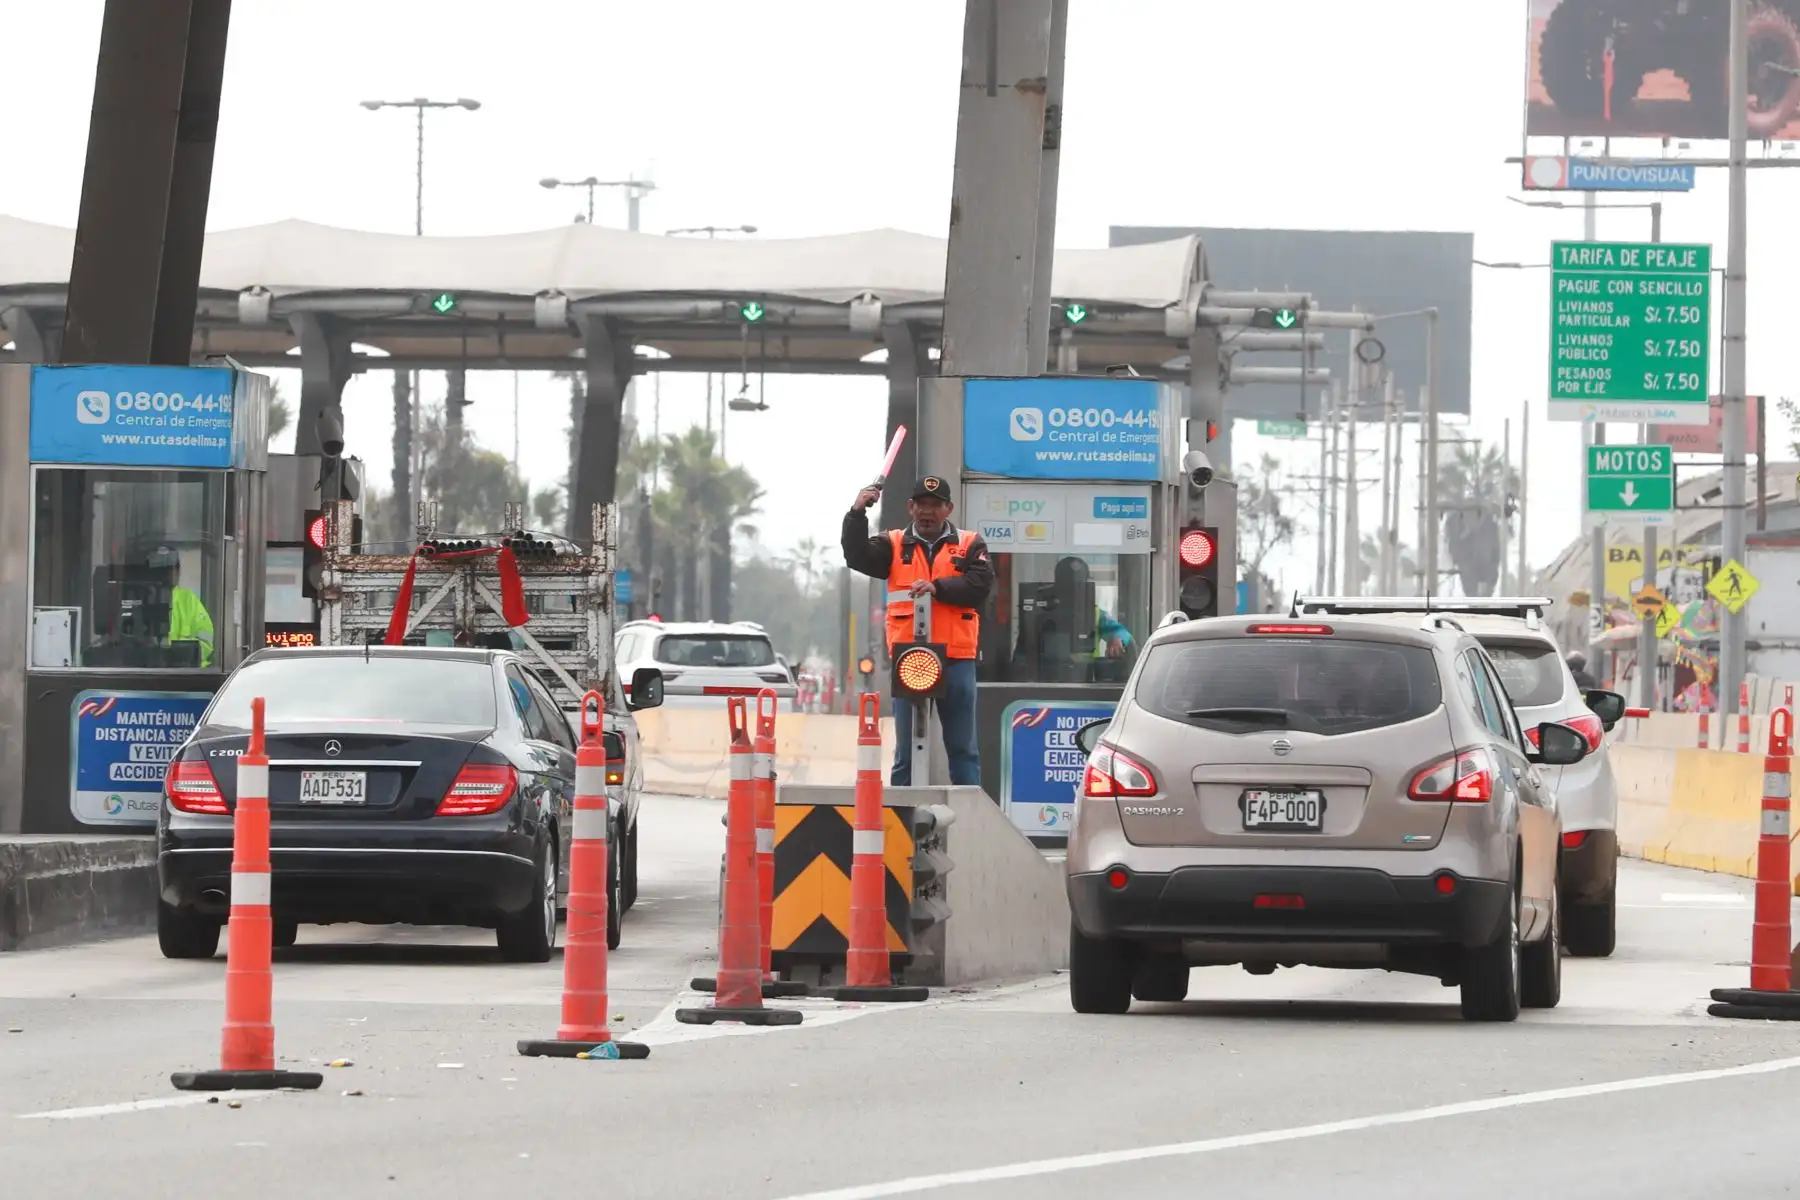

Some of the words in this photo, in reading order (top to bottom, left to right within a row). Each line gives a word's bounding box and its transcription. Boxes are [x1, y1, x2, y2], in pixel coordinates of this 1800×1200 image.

[1573, 165, 1688, 183] PUNTOVISUAL
[1561, 248, 1614, 265] TARIFA
[1620, 249, 1640, 266] DE
[1646, 250, 1697, 267] PEAJE
[1558, 280, 1600, 294] PAGUE
[1608, 281, 1633, 294] CON
[1640, 281, 1702, 296] SENCILLO
[1558, 301, 1613, 313] LIVIANOS
[1558, 314, 1630, 327] PARTICULAR
[1665, 307, 1700, 323] 7.50
[1558, 333, 1613, 346] LIVIANOS
[1665, 339, 1700, 357] 7.50
[1558, 367, 1611, 380] PESADOS
[1558, 381, 1580, 393] POR
[1584, 382, 1605, 394] EJE
[1665, 373, 1699, 391] 7.50
[115, 414, 167, 427] Central
[170, 415, 185, 427] de
[1049, 430, 1100, 443] Central
[1103, 431, 1117, 443] de
[1595, 451, 1662, 471] MOTOS
[983, 527, 1012, 538] VISA
[116, 710, 170, 726] MANTÉN
[173, 712, 195, 726] UNA
[1056, 716, 1075, 728] NO
[95, 727, 166, 742] DISTANCIA
[1049, 732, 1064, 746] EL
[134, 746, 143, 759] Y
[209, 749, 217, 757] C
[218, 749, 243, 757] 200
[1048, 751, 1085, 766] EMER
[322, 771, 346, 779] PERU
[302, 779, 363, 798] AAD-531
[128, 799, 159, 810] Rutas
[1248, 800, 1317, 822] F4P-000
